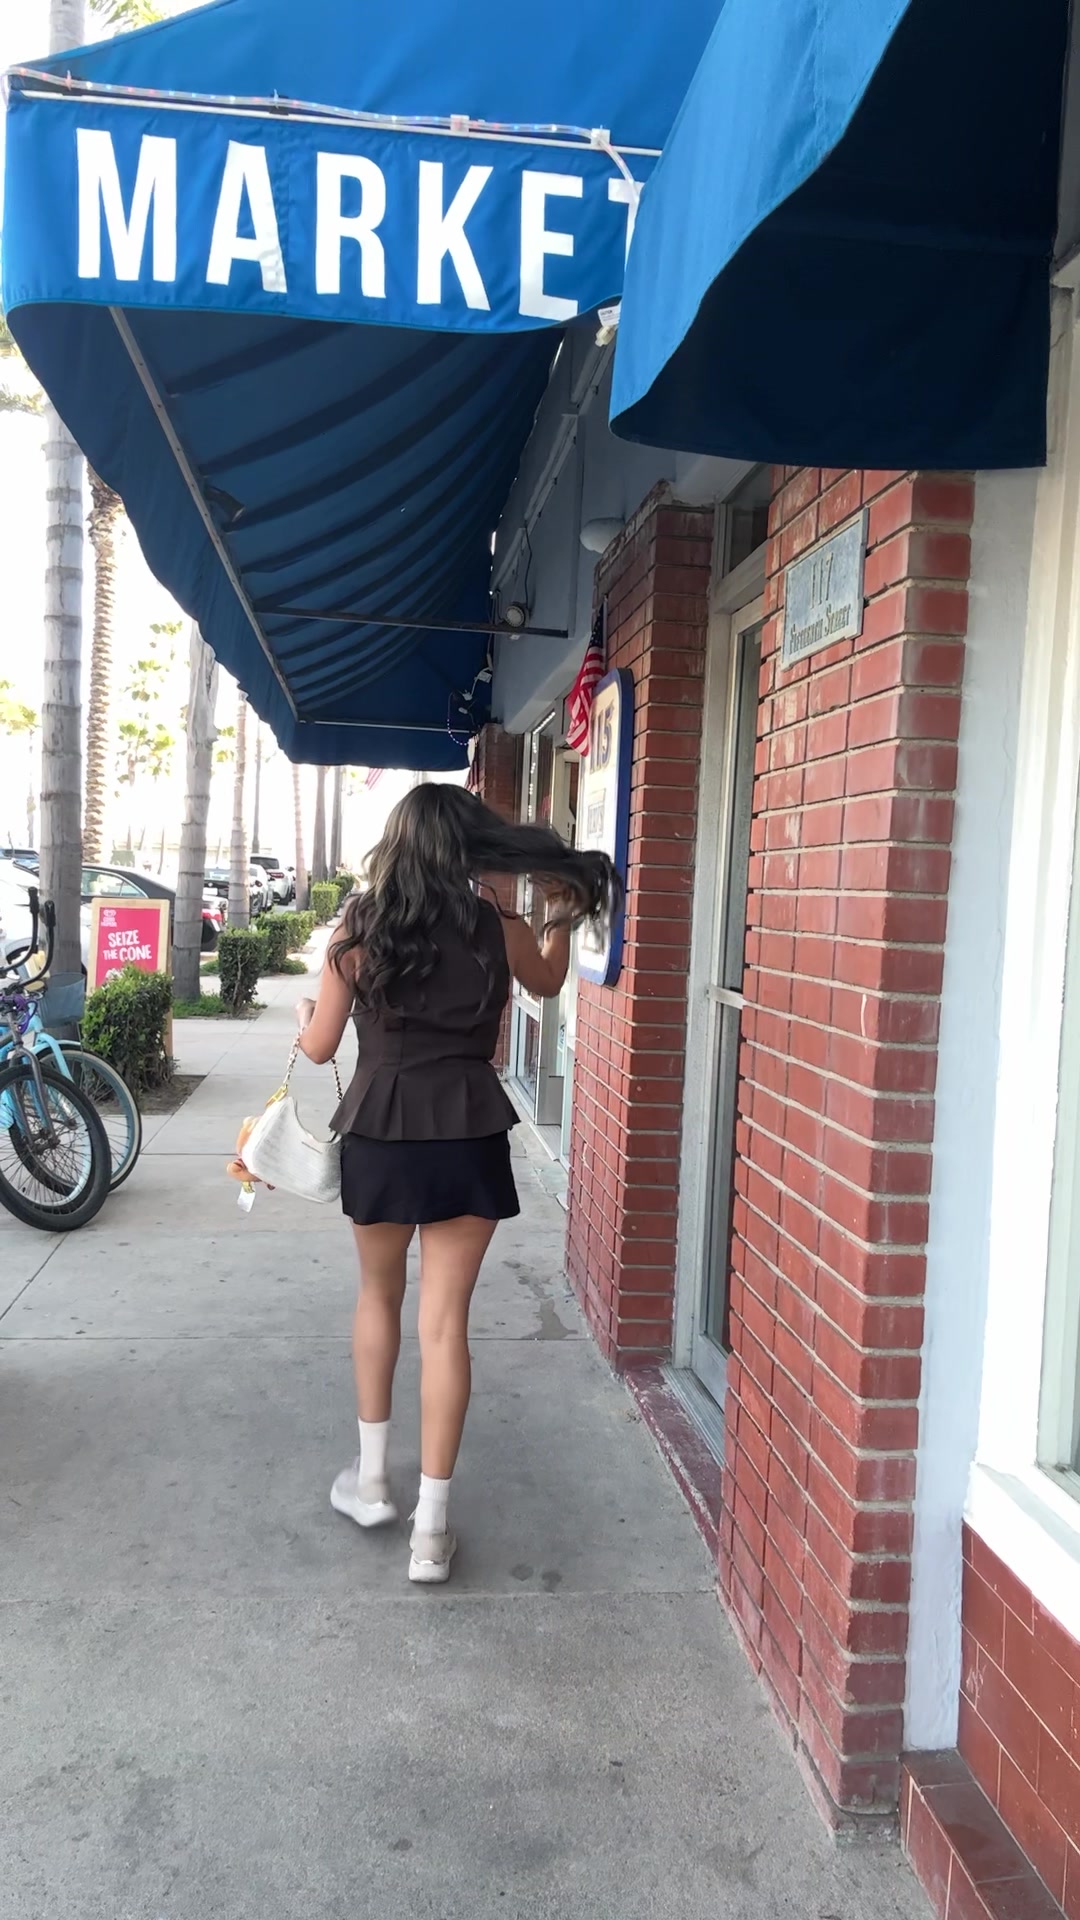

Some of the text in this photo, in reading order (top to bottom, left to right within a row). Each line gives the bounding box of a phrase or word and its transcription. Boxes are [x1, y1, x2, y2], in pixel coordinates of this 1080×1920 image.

[811, 552, 834, 610] 117
[590, 701, 614, 775] 115
[103, 944, 152, 962] THE CONE
[108, 929, 140, 948] SEIZE
